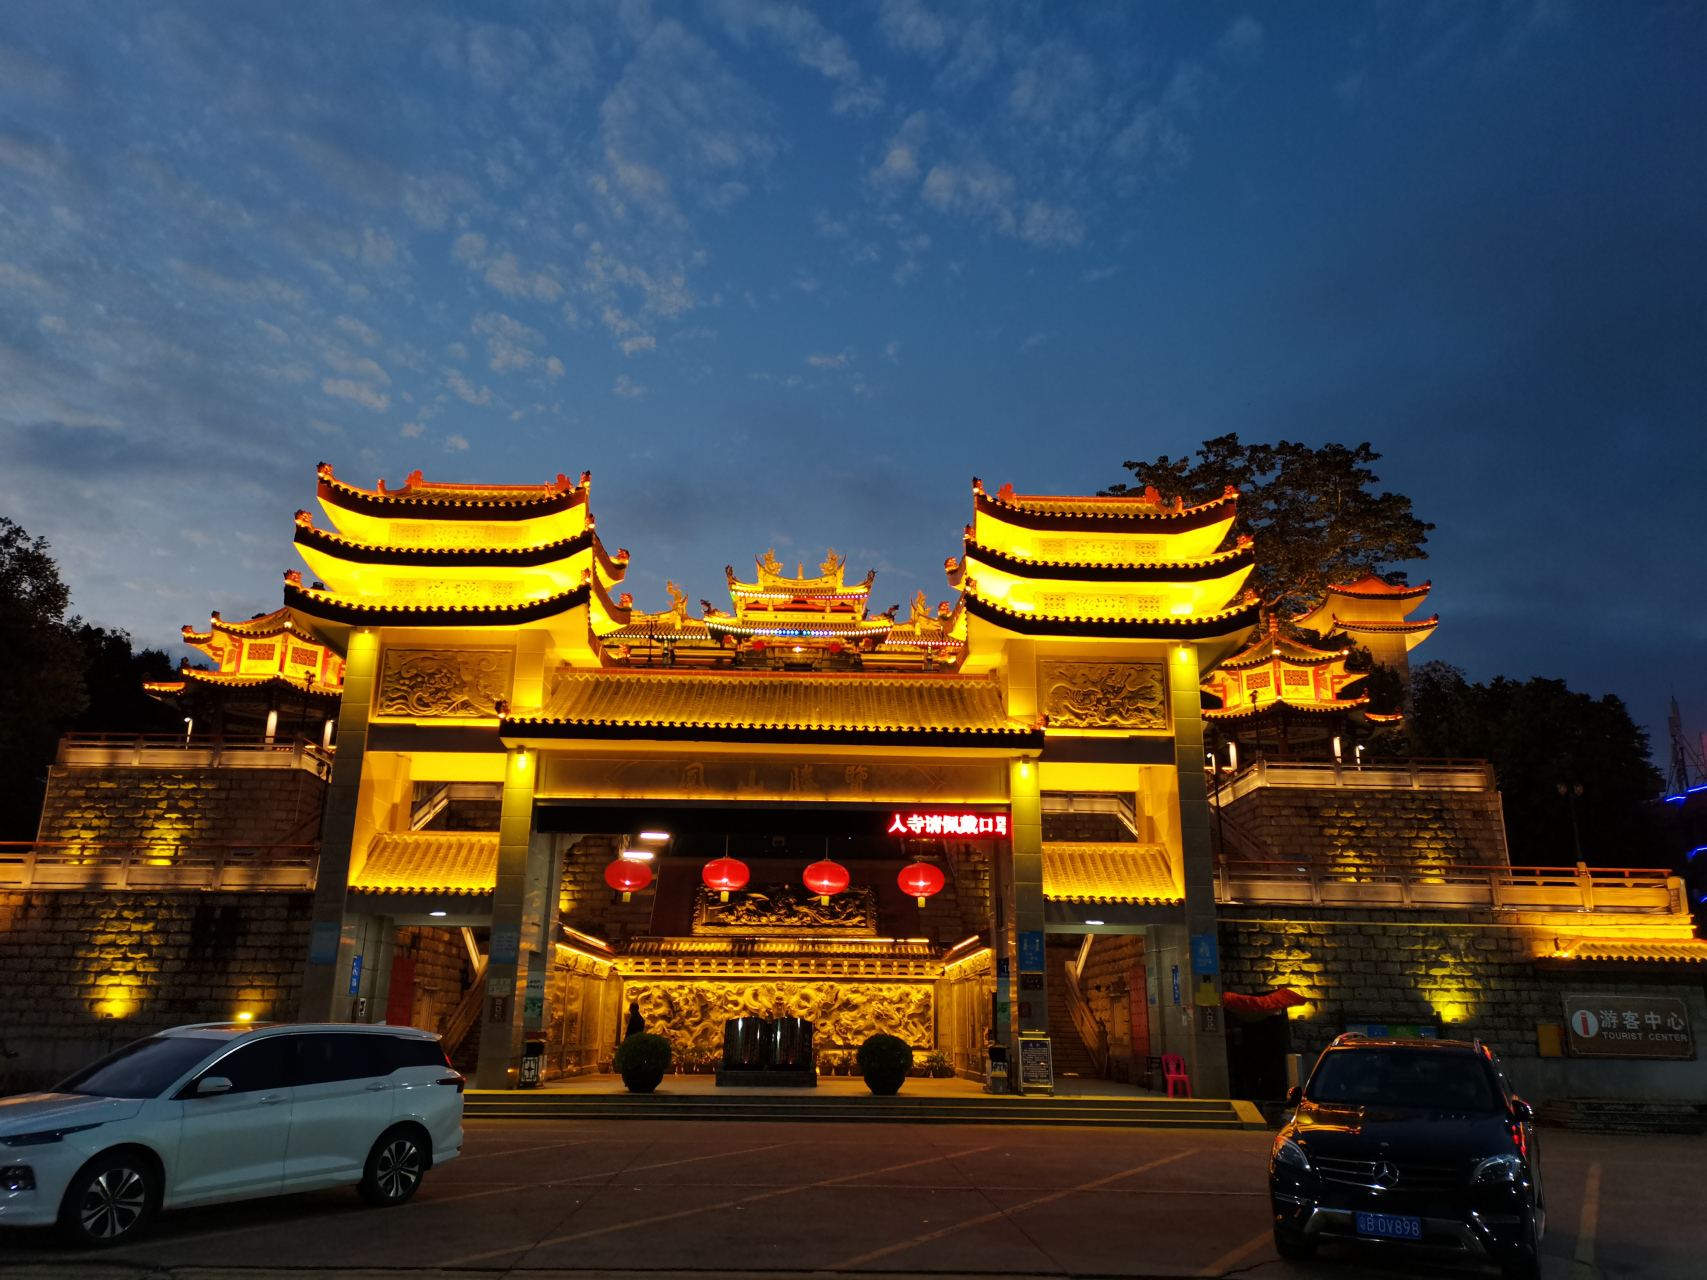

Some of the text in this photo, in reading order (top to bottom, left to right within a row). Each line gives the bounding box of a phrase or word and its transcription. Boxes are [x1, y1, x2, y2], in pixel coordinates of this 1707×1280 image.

[1599, 1009, 1685, 1031] 游客中心
[1602, 1031, 1688, 1042] TOURIST CENTER
